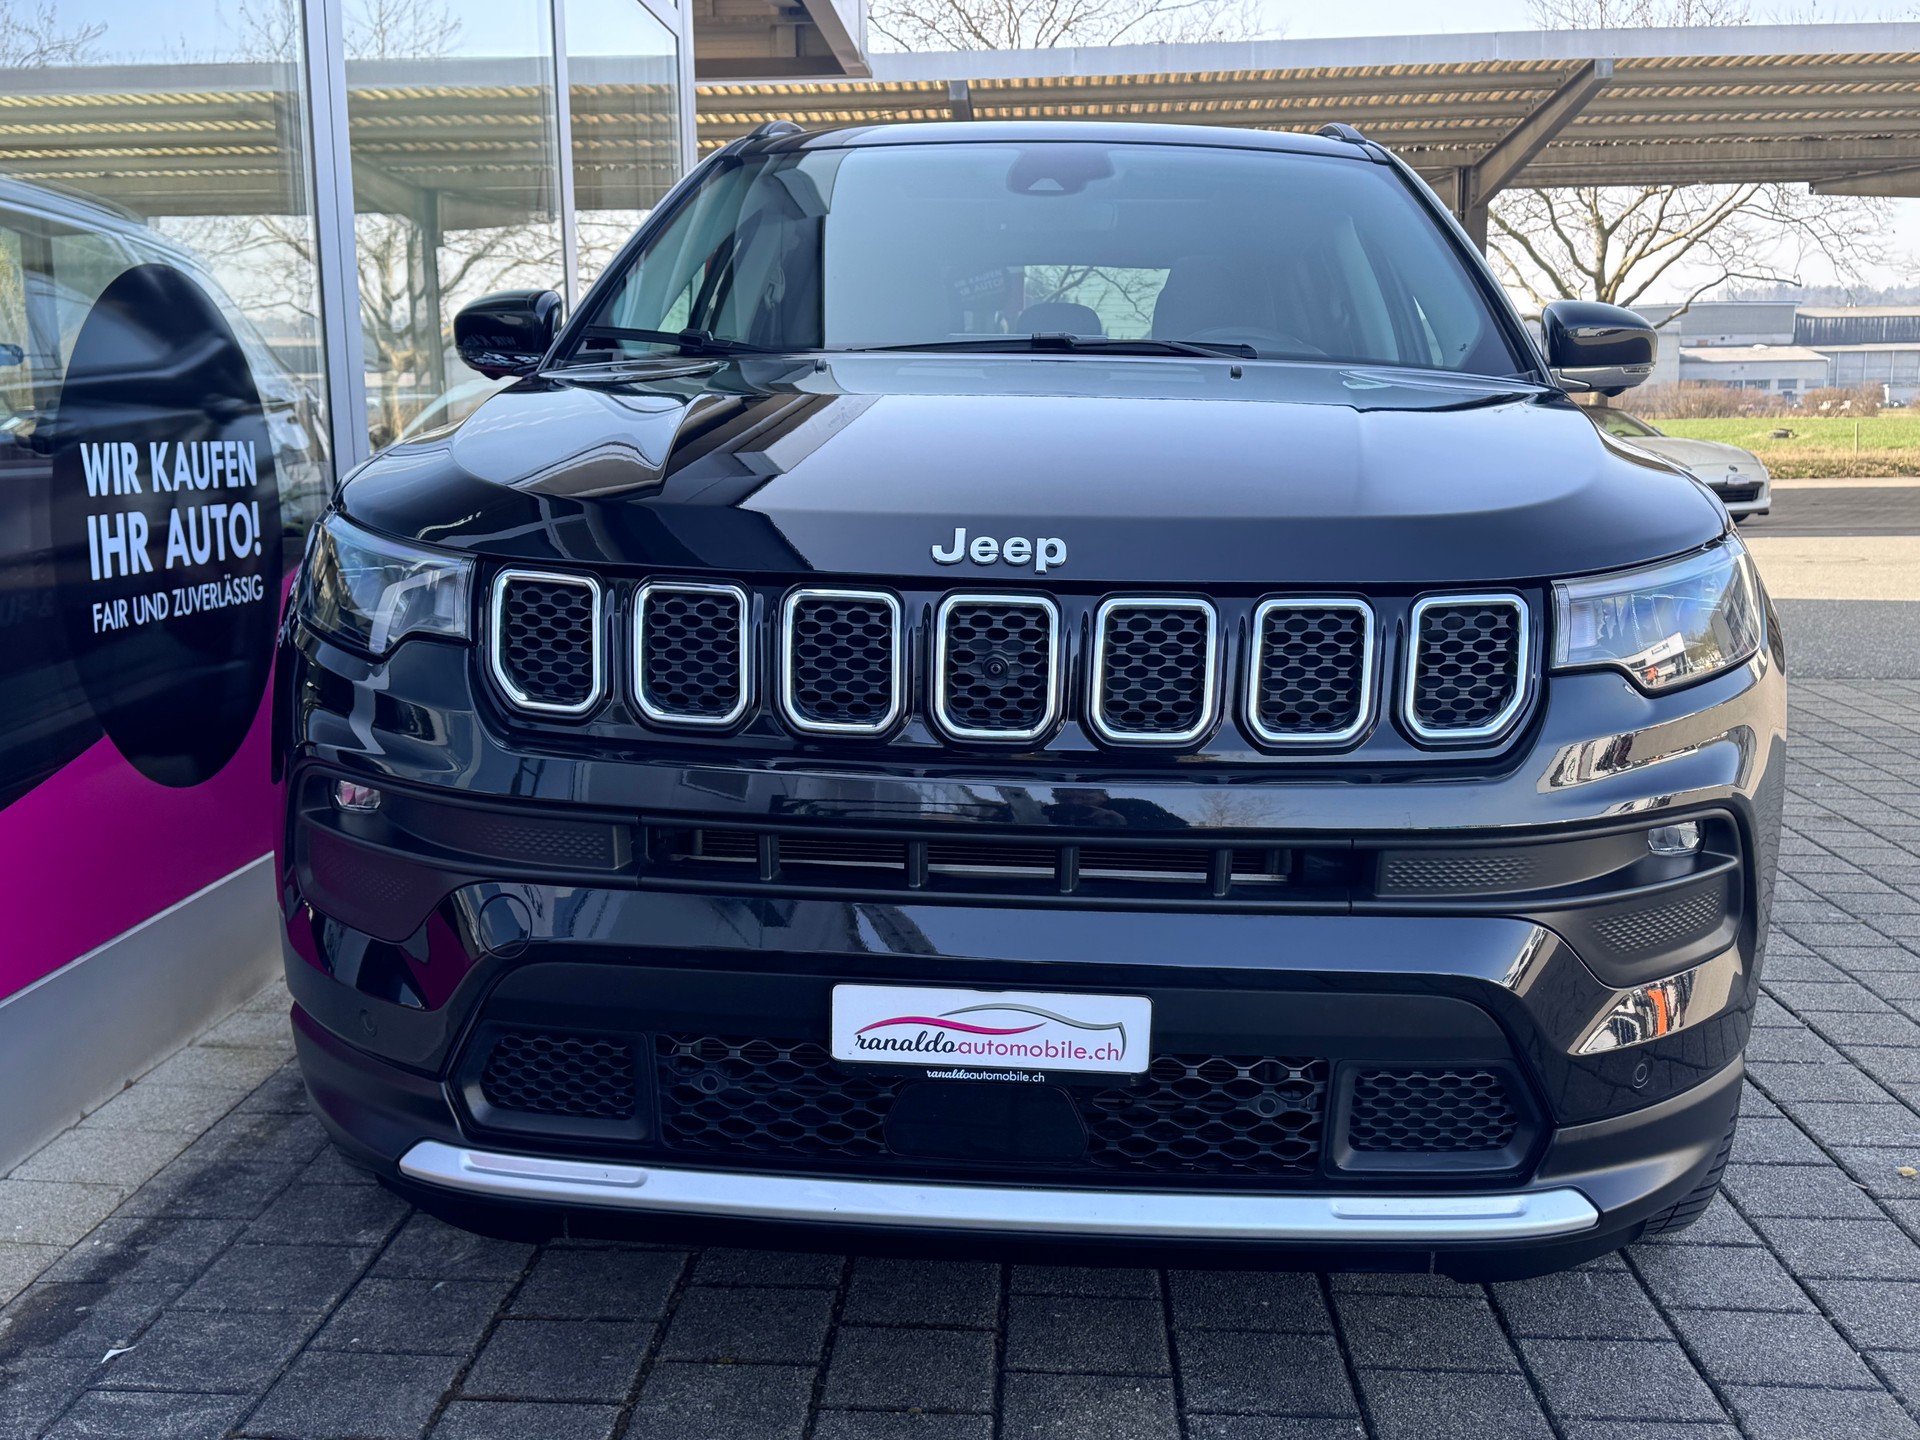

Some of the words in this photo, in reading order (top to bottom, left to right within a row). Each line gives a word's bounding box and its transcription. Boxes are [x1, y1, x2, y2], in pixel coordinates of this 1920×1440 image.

[80, 441, 142, 497] WIR
[149, 440, 257, 493] KAUFEN
[87, 511, 153, 581] IHR
[165, 501, 262, 569] AUTO!
[931, 527, 1067, 574] Jeep
[93, 598, 129, 633] FAIR
[132, 591, 169, 625] UND
[172, 574, 264, 617] ZUVERLÄSSIG
[855, 1031, 1121, 1061] ranaldoautomobile.ch
[926, 1069, 1045, 1083] ranaldoautomobile.ch
